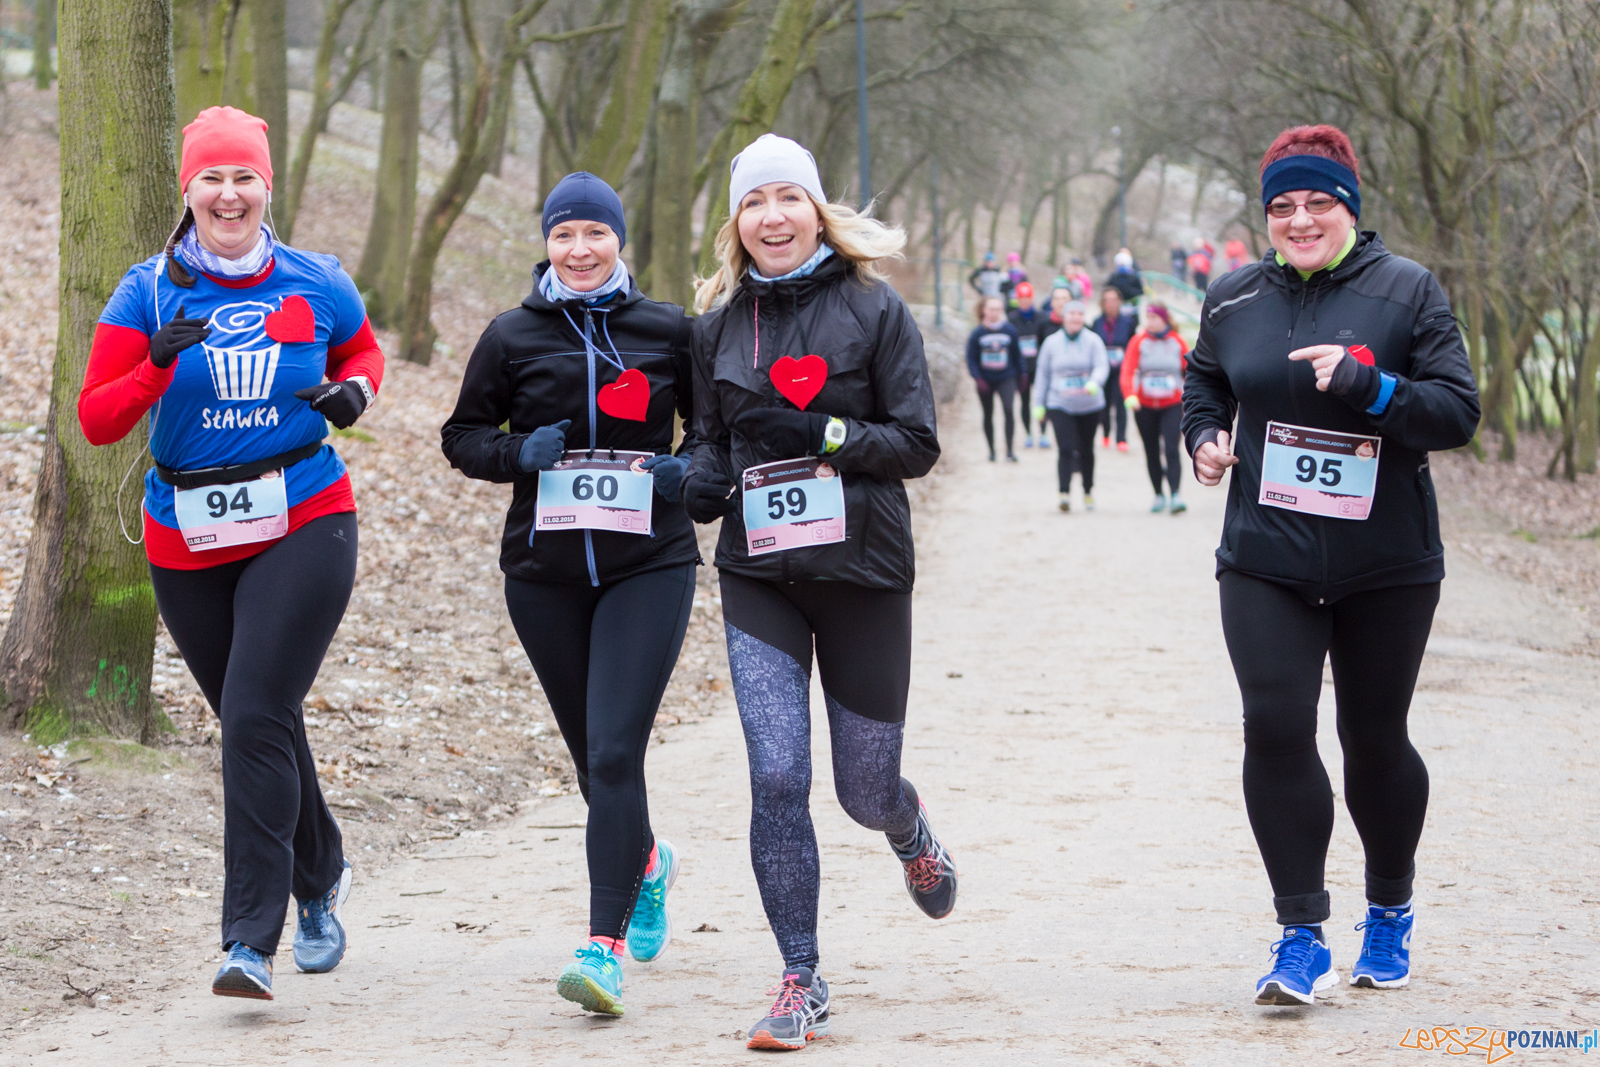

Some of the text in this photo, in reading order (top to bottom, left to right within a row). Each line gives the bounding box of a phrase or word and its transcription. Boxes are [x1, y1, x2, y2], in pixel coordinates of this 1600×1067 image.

[1295, 454, 1343, 487] 95
[206, 486, 253, 519] 94
[572, 474, 619, 502] 60
[767, 486, 807, 520] 59
[1267, 492, 1296, 504] 11.02.2018
[543, 516, 575, 524] 11.02.2018
